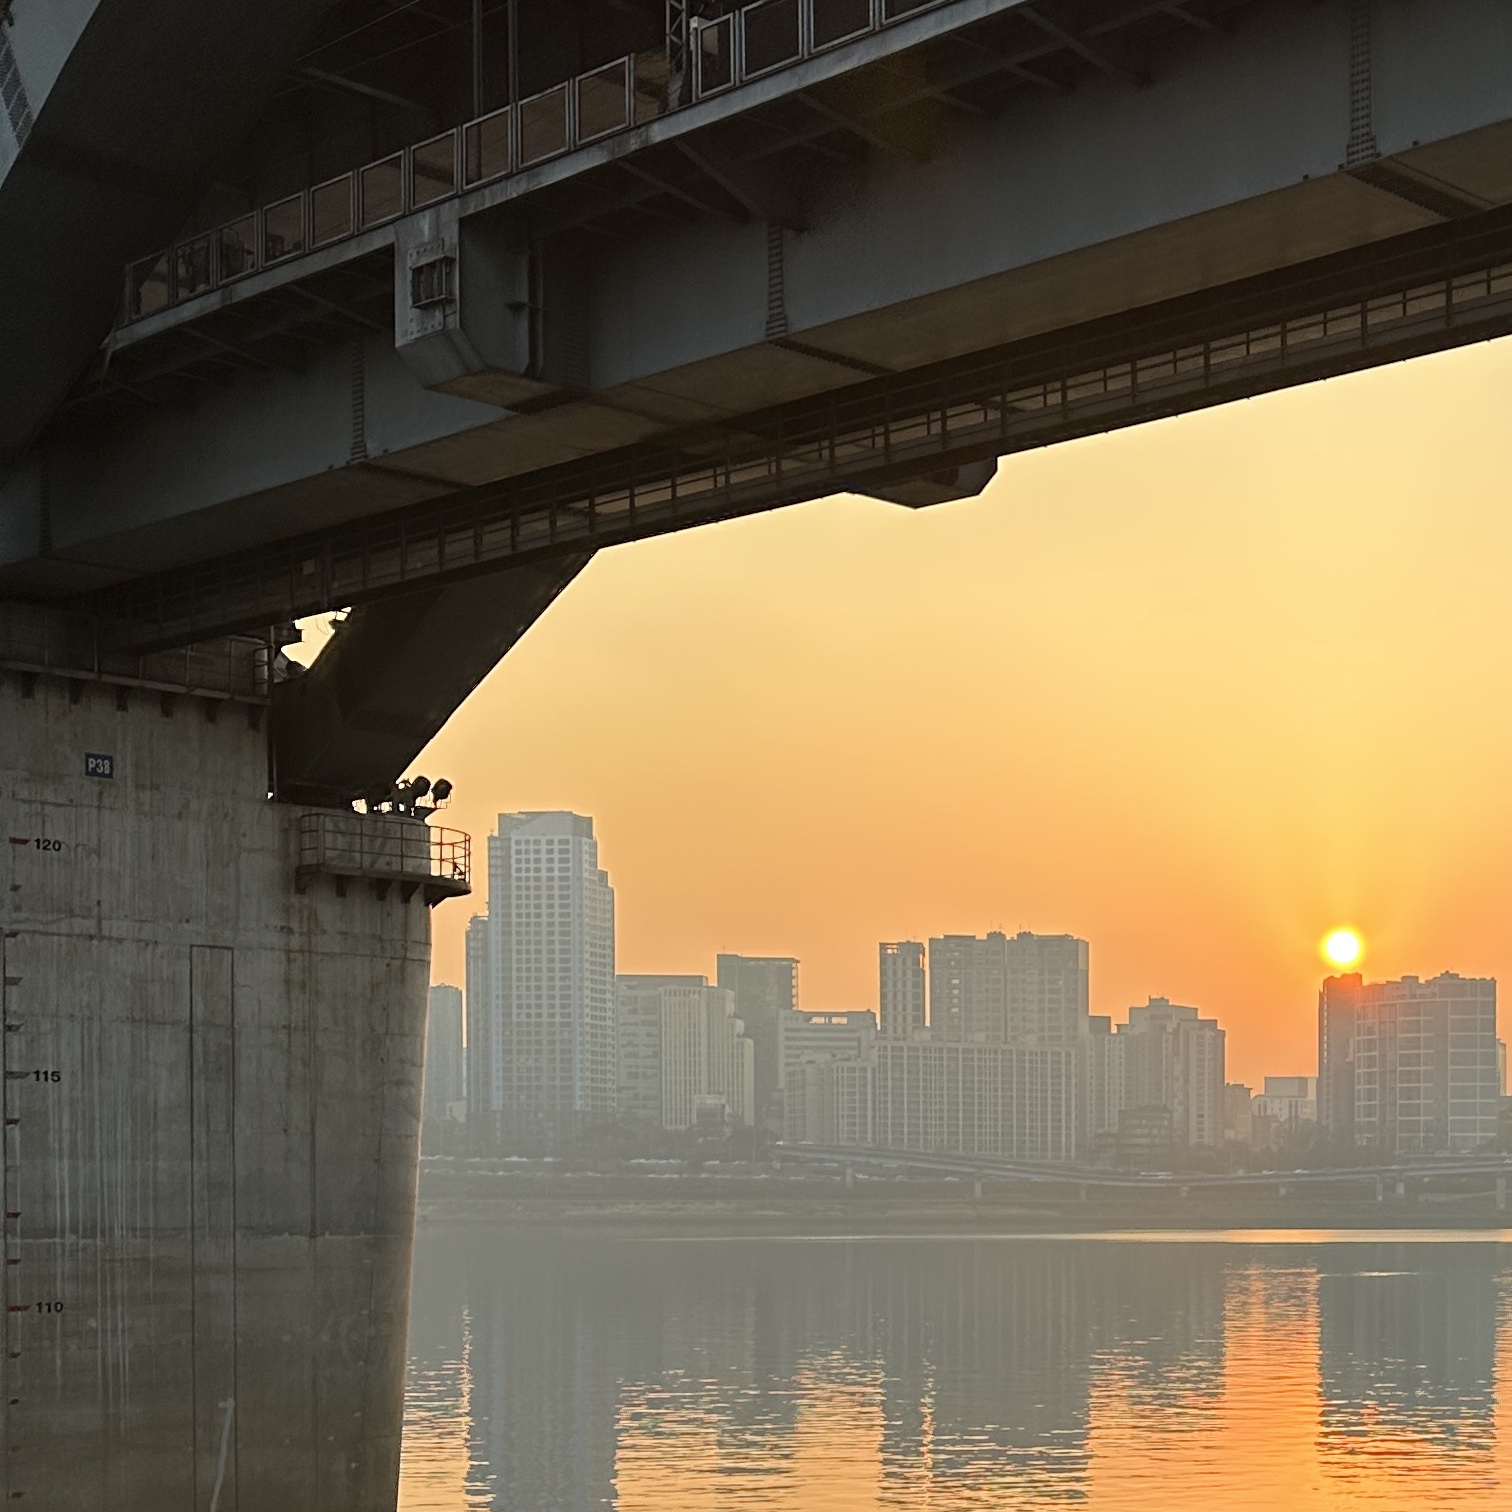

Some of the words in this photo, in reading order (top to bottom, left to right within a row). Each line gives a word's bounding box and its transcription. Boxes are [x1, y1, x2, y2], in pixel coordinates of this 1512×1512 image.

[88, 758, 111, 775] P38
[34, 838, 62, 852] 120
[33, 1069, 61, 1083] 115
[36, 1301, 64, 1314] 110
